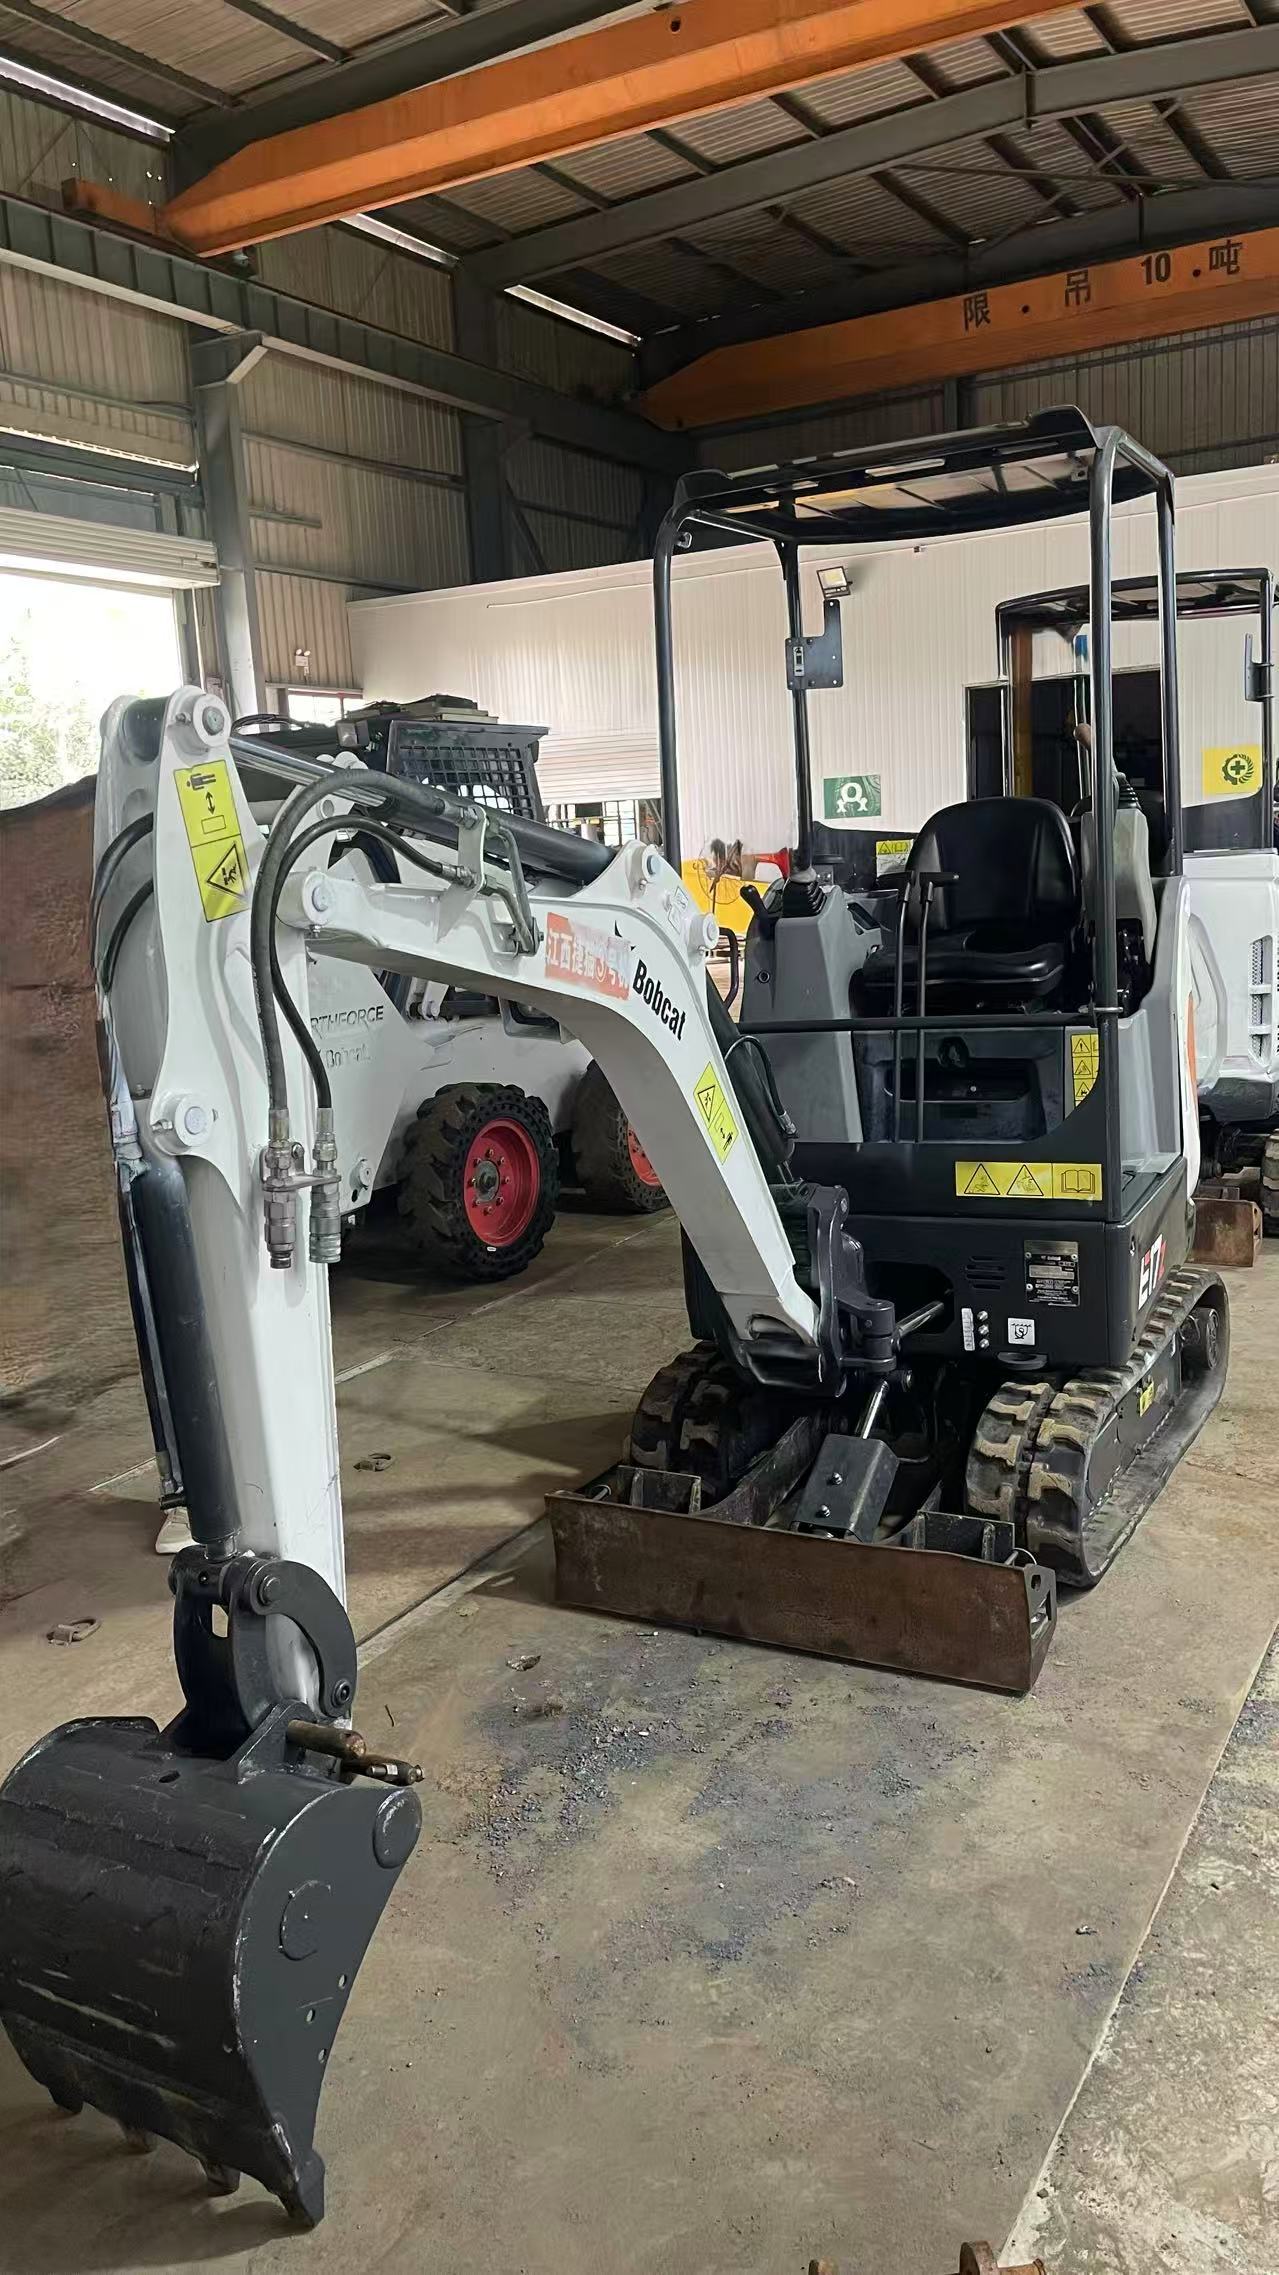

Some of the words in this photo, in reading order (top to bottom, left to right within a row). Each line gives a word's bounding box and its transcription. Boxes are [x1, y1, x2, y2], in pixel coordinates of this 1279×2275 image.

[963, 290, 990, 331] 限
[1064, 268, 1091, 307] 吊
[1141, 252, 1172, 285] 10
[1208, 239, 1242, 276] 吨
[632, 959, 688, 1041] Bobcat
